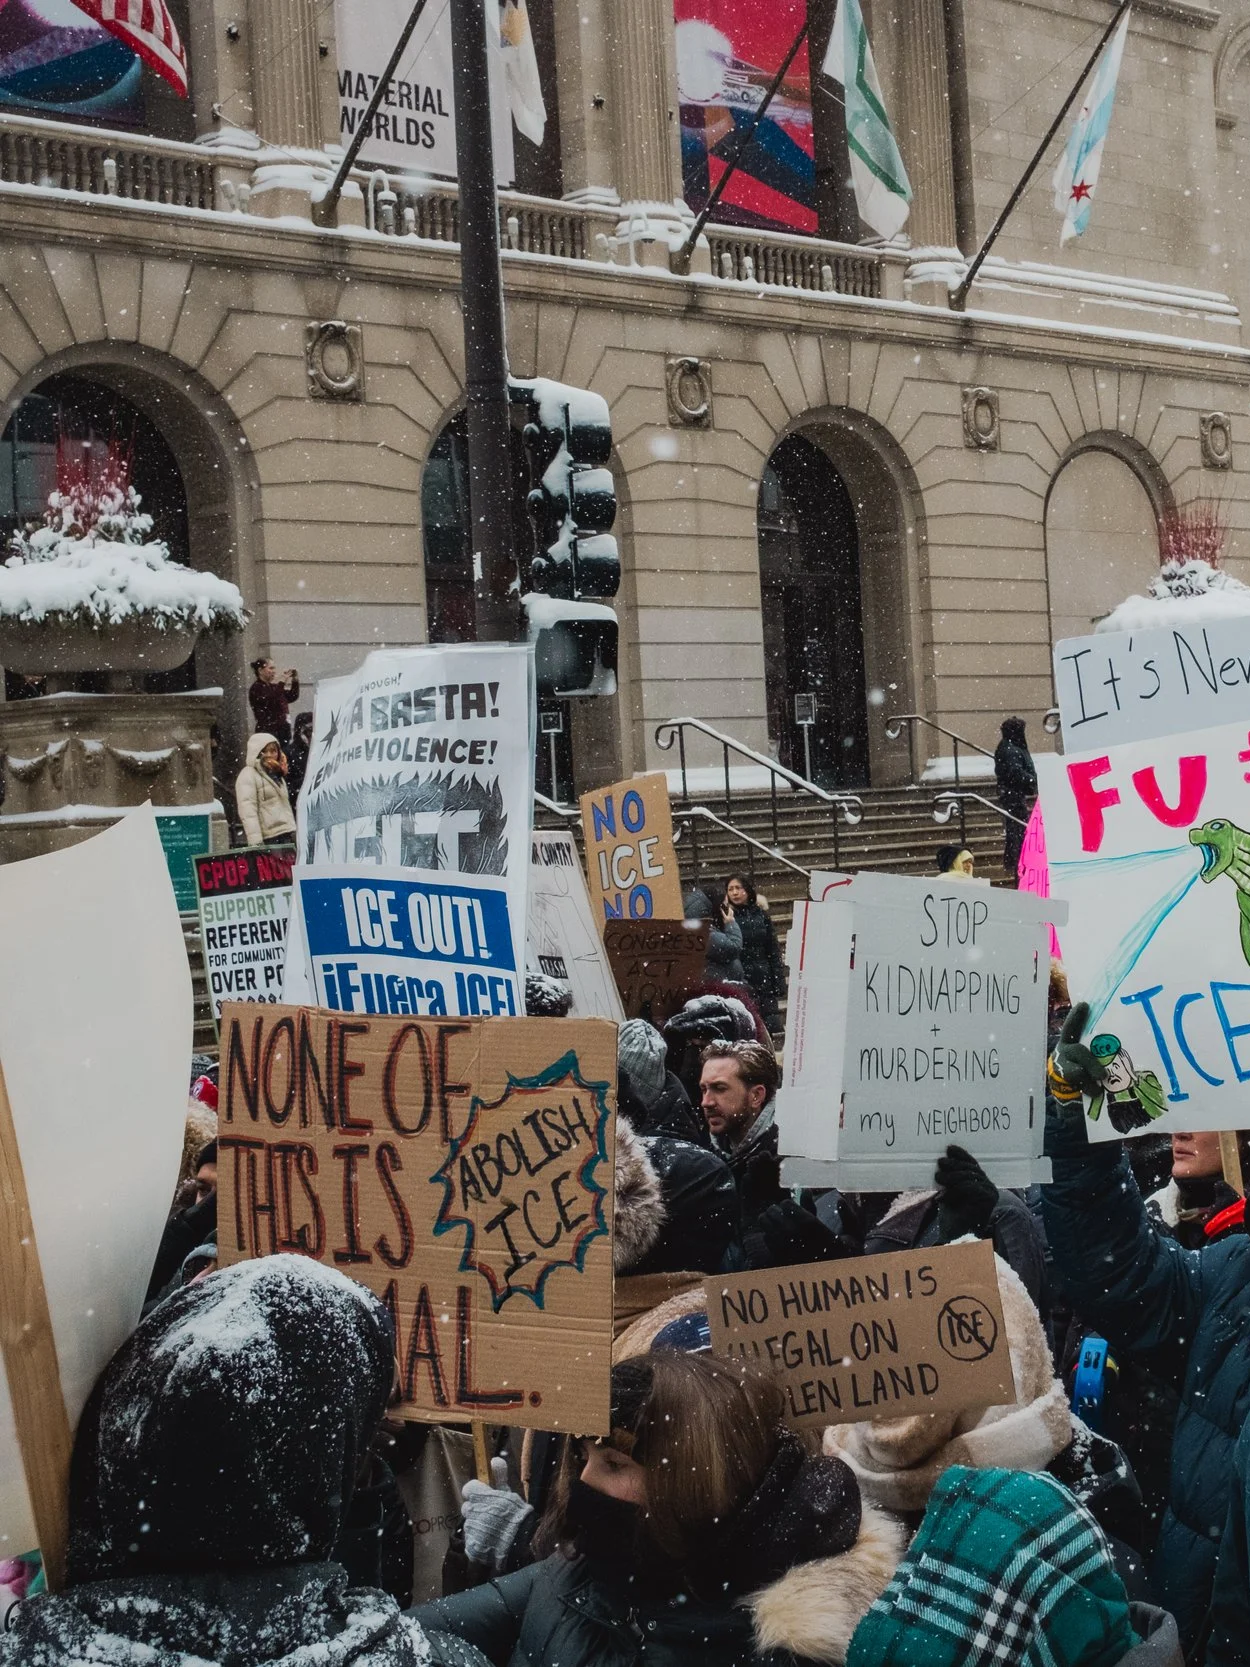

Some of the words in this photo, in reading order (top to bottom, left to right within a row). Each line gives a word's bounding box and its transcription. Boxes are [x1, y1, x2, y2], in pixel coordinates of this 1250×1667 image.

[370, 682, 500, 733] BASTA!
[1060, 637, 1161, 728] It's
[341, 745, 362, 764] THE
[364, 736, 498, 765] VIOLENCE!
[592, 790, 646, 843] NO
[200, 858, 249, 891] CPOP
[597, 836, 665, 891] ICE
[203, 893, 275, 923] SUPPORT
[341, 887, 404, 950] ICE
[407, 891, 491, 960] OUT!
[602, 884, 654, 920] NO
[919, 893, 988, 949] STOP
[208, 953, 228, 968] FOR
[605, 930, 707, 951] CONGRESS
[211, 967, 256, 994] OVER
[321, 962, 448, 1016] ¡Fuera
[626, 959, 681, 979] ACT
[864, 961, 1021, 1016] KIDNAPPING
[223, 1014, 373, 1135] NONE
[382, 1022, 471, 1145] OF
[859, 1111, 896, 1147] my
[916, 1106, 1011, 1136] NEIGHBORS
[458, 1096, 594, 1210] ABOLISH
[217, 1135, 326, 1258] THIS
[332, 1140, 415, 1270] IS
[484, 1170, 590, 1268] ICE
[720, 1288, 768, 1328] NO
[777, 1272, 889, 1319] HUMAN
[904, 1266, 938, 1299] IS
[850, 1318, 898, 1361] ON
[946, 1310, 984, 1348] ICE
[851, 1363, 939, 1407] LAND
